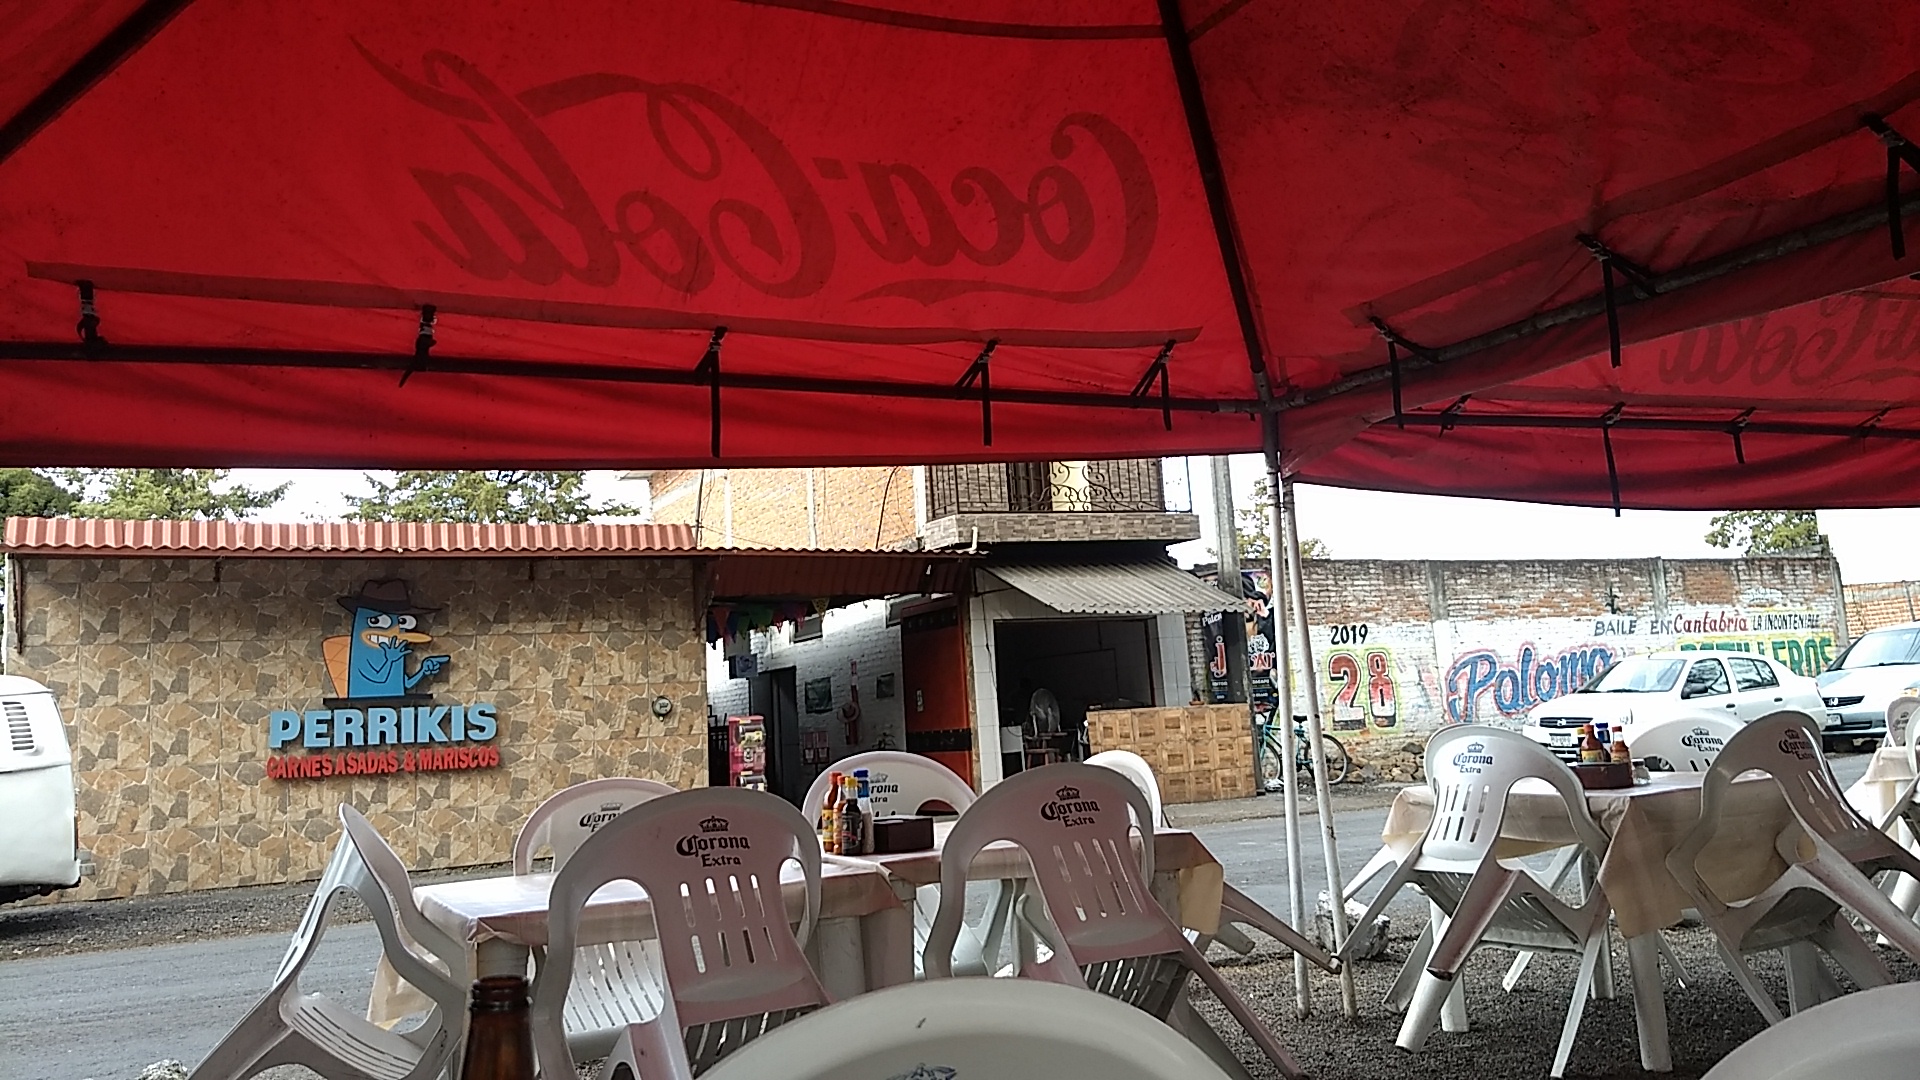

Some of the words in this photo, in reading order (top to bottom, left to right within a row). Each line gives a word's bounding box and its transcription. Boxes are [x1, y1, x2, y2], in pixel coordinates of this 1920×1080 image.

[1594, 619, 1637, 636] BAILE
[1673, 610, 1749, 633] Cantabria
[1330, 623, 1369, 645] 2019
[1328, 651, 1398, 732] 28
[269, 703, 497, 749] PERRIKIS
[266, 753, 333, 779] CARNES
[334, 751, 398, 775] ASADAS
[403, 750, 416, 772] &
[418, 744, 500, 771] MARISCOS
[1453, 753, 1493, 767] Corona
[1459, 765, 1482, 774] Extra
[1040, 799, 1100, 822] Corona
[1062, 815, 1096, 828] Extra
[676, 834, 751, 858] Corona
[700, 853, 742, 868] Extra
